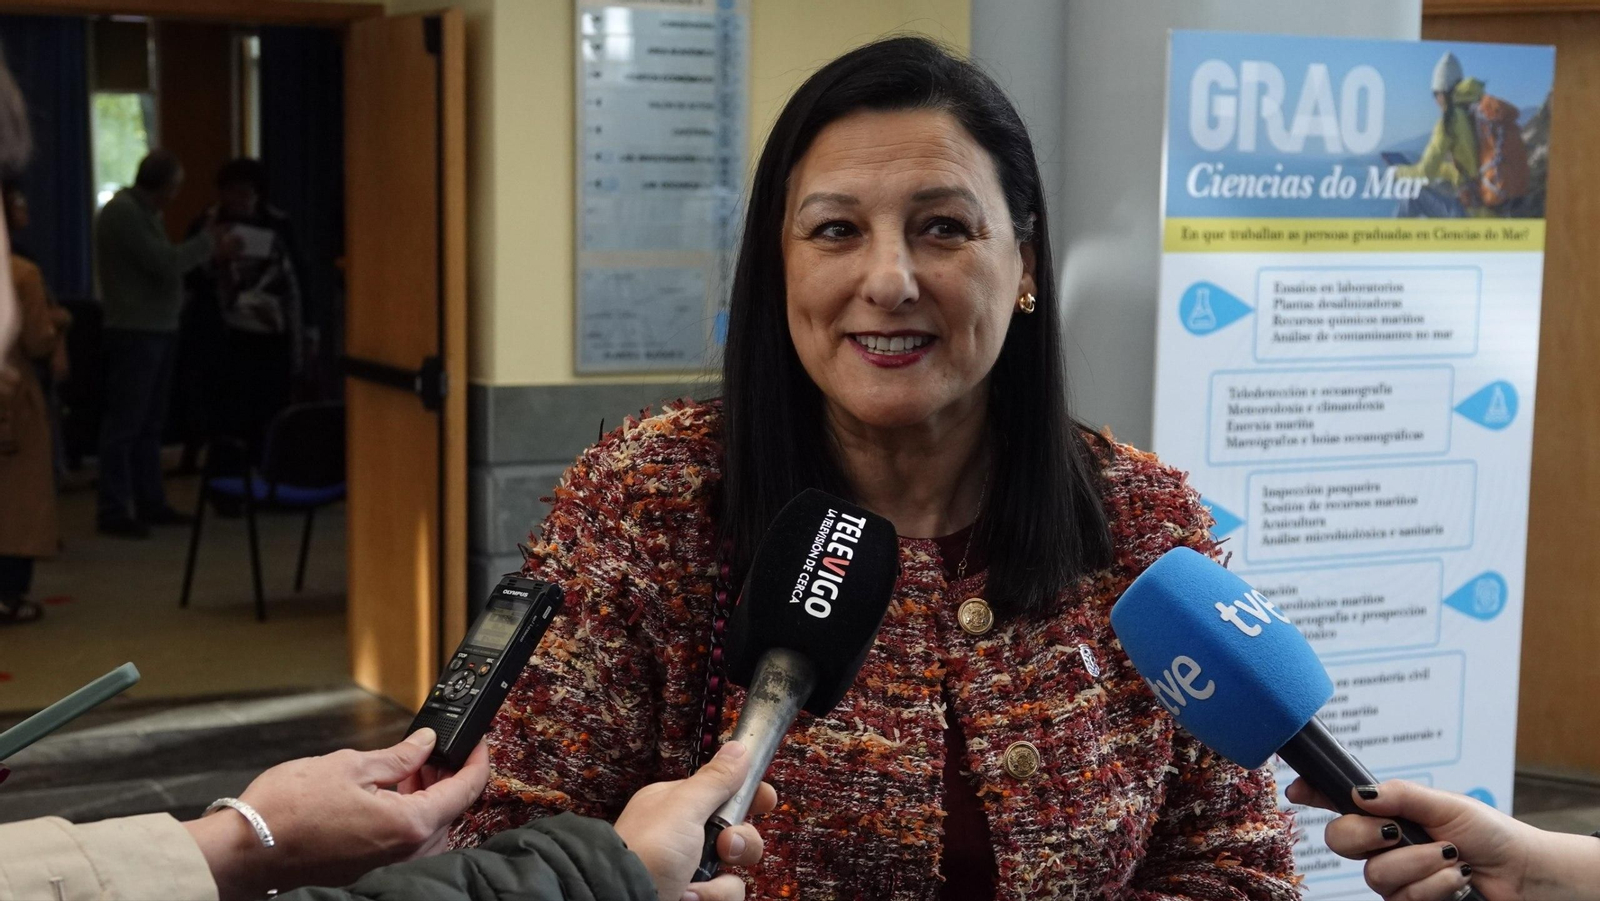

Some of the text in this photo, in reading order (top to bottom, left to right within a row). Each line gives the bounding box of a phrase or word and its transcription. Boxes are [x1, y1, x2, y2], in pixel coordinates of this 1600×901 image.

[1189, 58, 1385, 155] GRAO
[1186, 162, 1428, 199] Ciencias do Mar
[1203, 229, 1225, 245] que
[1353, 226, 1413, 245] graduadas
[1433, 226, 1481, 241] Ciencias
[789, 508, 839, 604] LA TELEVISIÓN DE CERCA
[804, 513, 867, 619] TELEVIGO
[502, 588, 529, 598] OLYMPUS
[1215, 589, 1291, 637] tve
